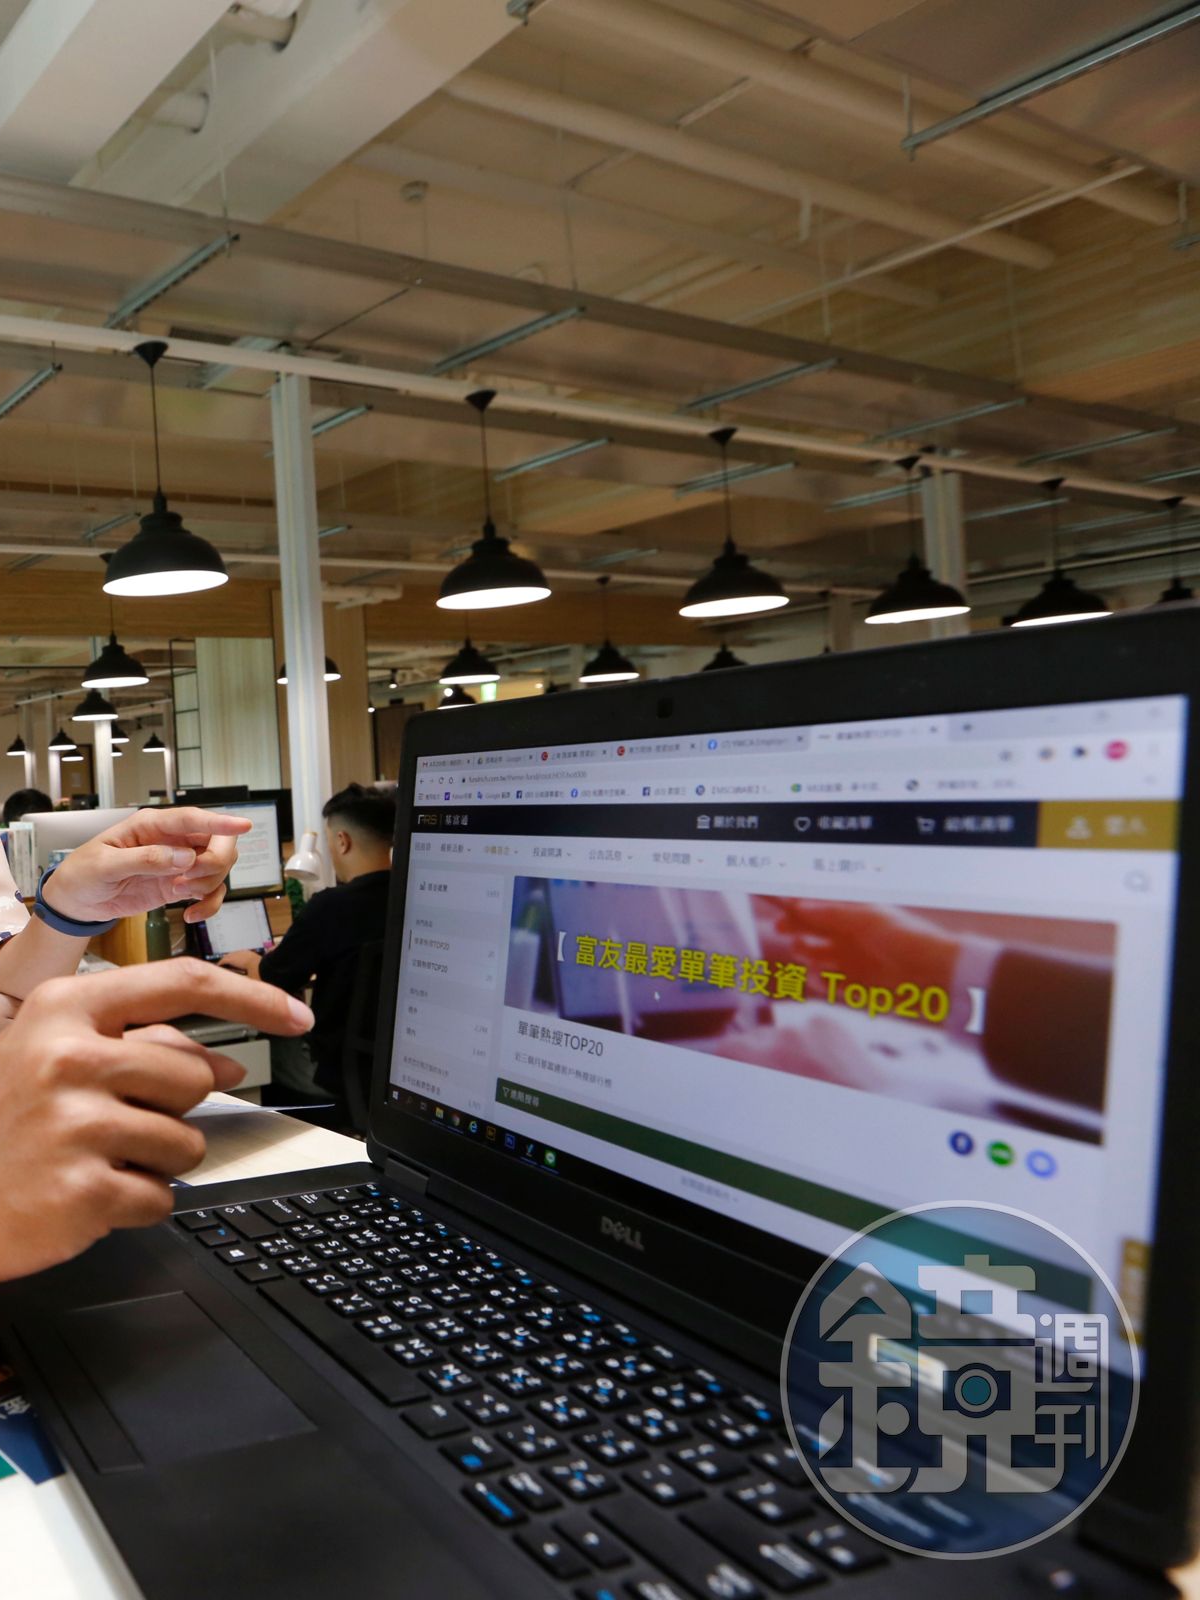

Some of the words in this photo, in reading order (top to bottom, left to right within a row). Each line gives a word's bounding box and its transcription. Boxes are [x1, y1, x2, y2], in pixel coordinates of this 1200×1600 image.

[575, 935, 808, 1003] 富友最愛單筆投資
[820, 971, 949, 1024] Top20
[517, 1020, 605, 1058] 單筆熱搜TOP20
[601, 1215, 645, 1250] DELL
